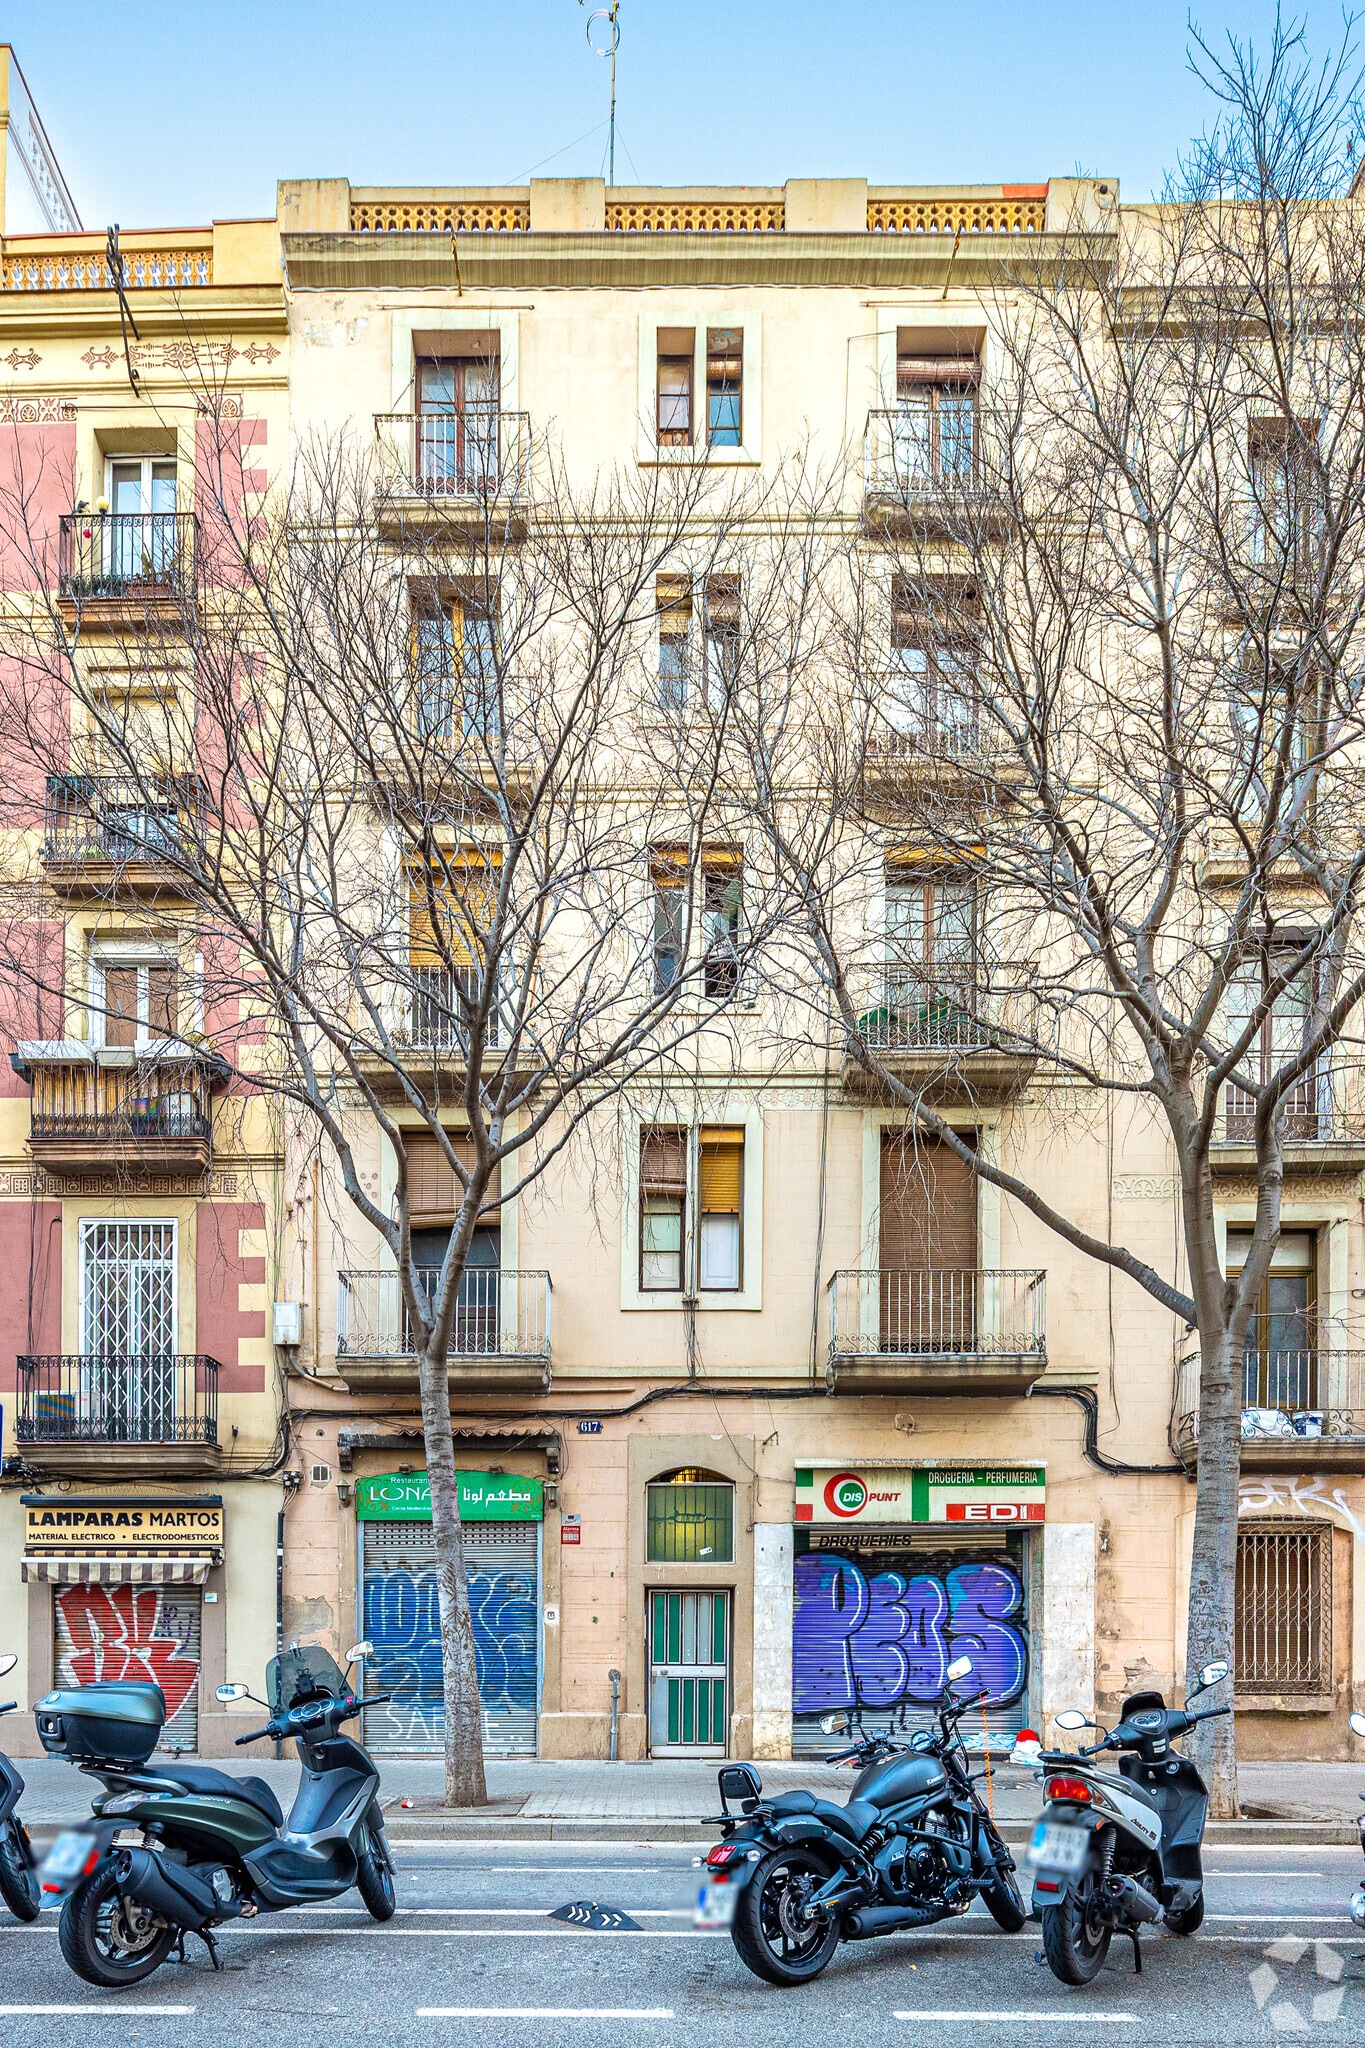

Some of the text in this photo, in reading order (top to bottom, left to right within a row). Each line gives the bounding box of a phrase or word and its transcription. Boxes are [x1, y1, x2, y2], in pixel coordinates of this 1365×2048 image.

[580, 1421, 599, 1432] 617
[390, 1476, 430, 1484] Restauran
[928, 1471, 1038, 1484] DROGUERIA PERFUMERIA
[842, 1491, 901, 1503] DIS PUNT
[28, 1512, 220, 1527] LAMPARAS MARTOS
[28, 1533, 220, 1541] MATERIAL ELECTRICO ELECTRODOMESTICOS
[819, 1535, 912, 1548] DROGUERIES
